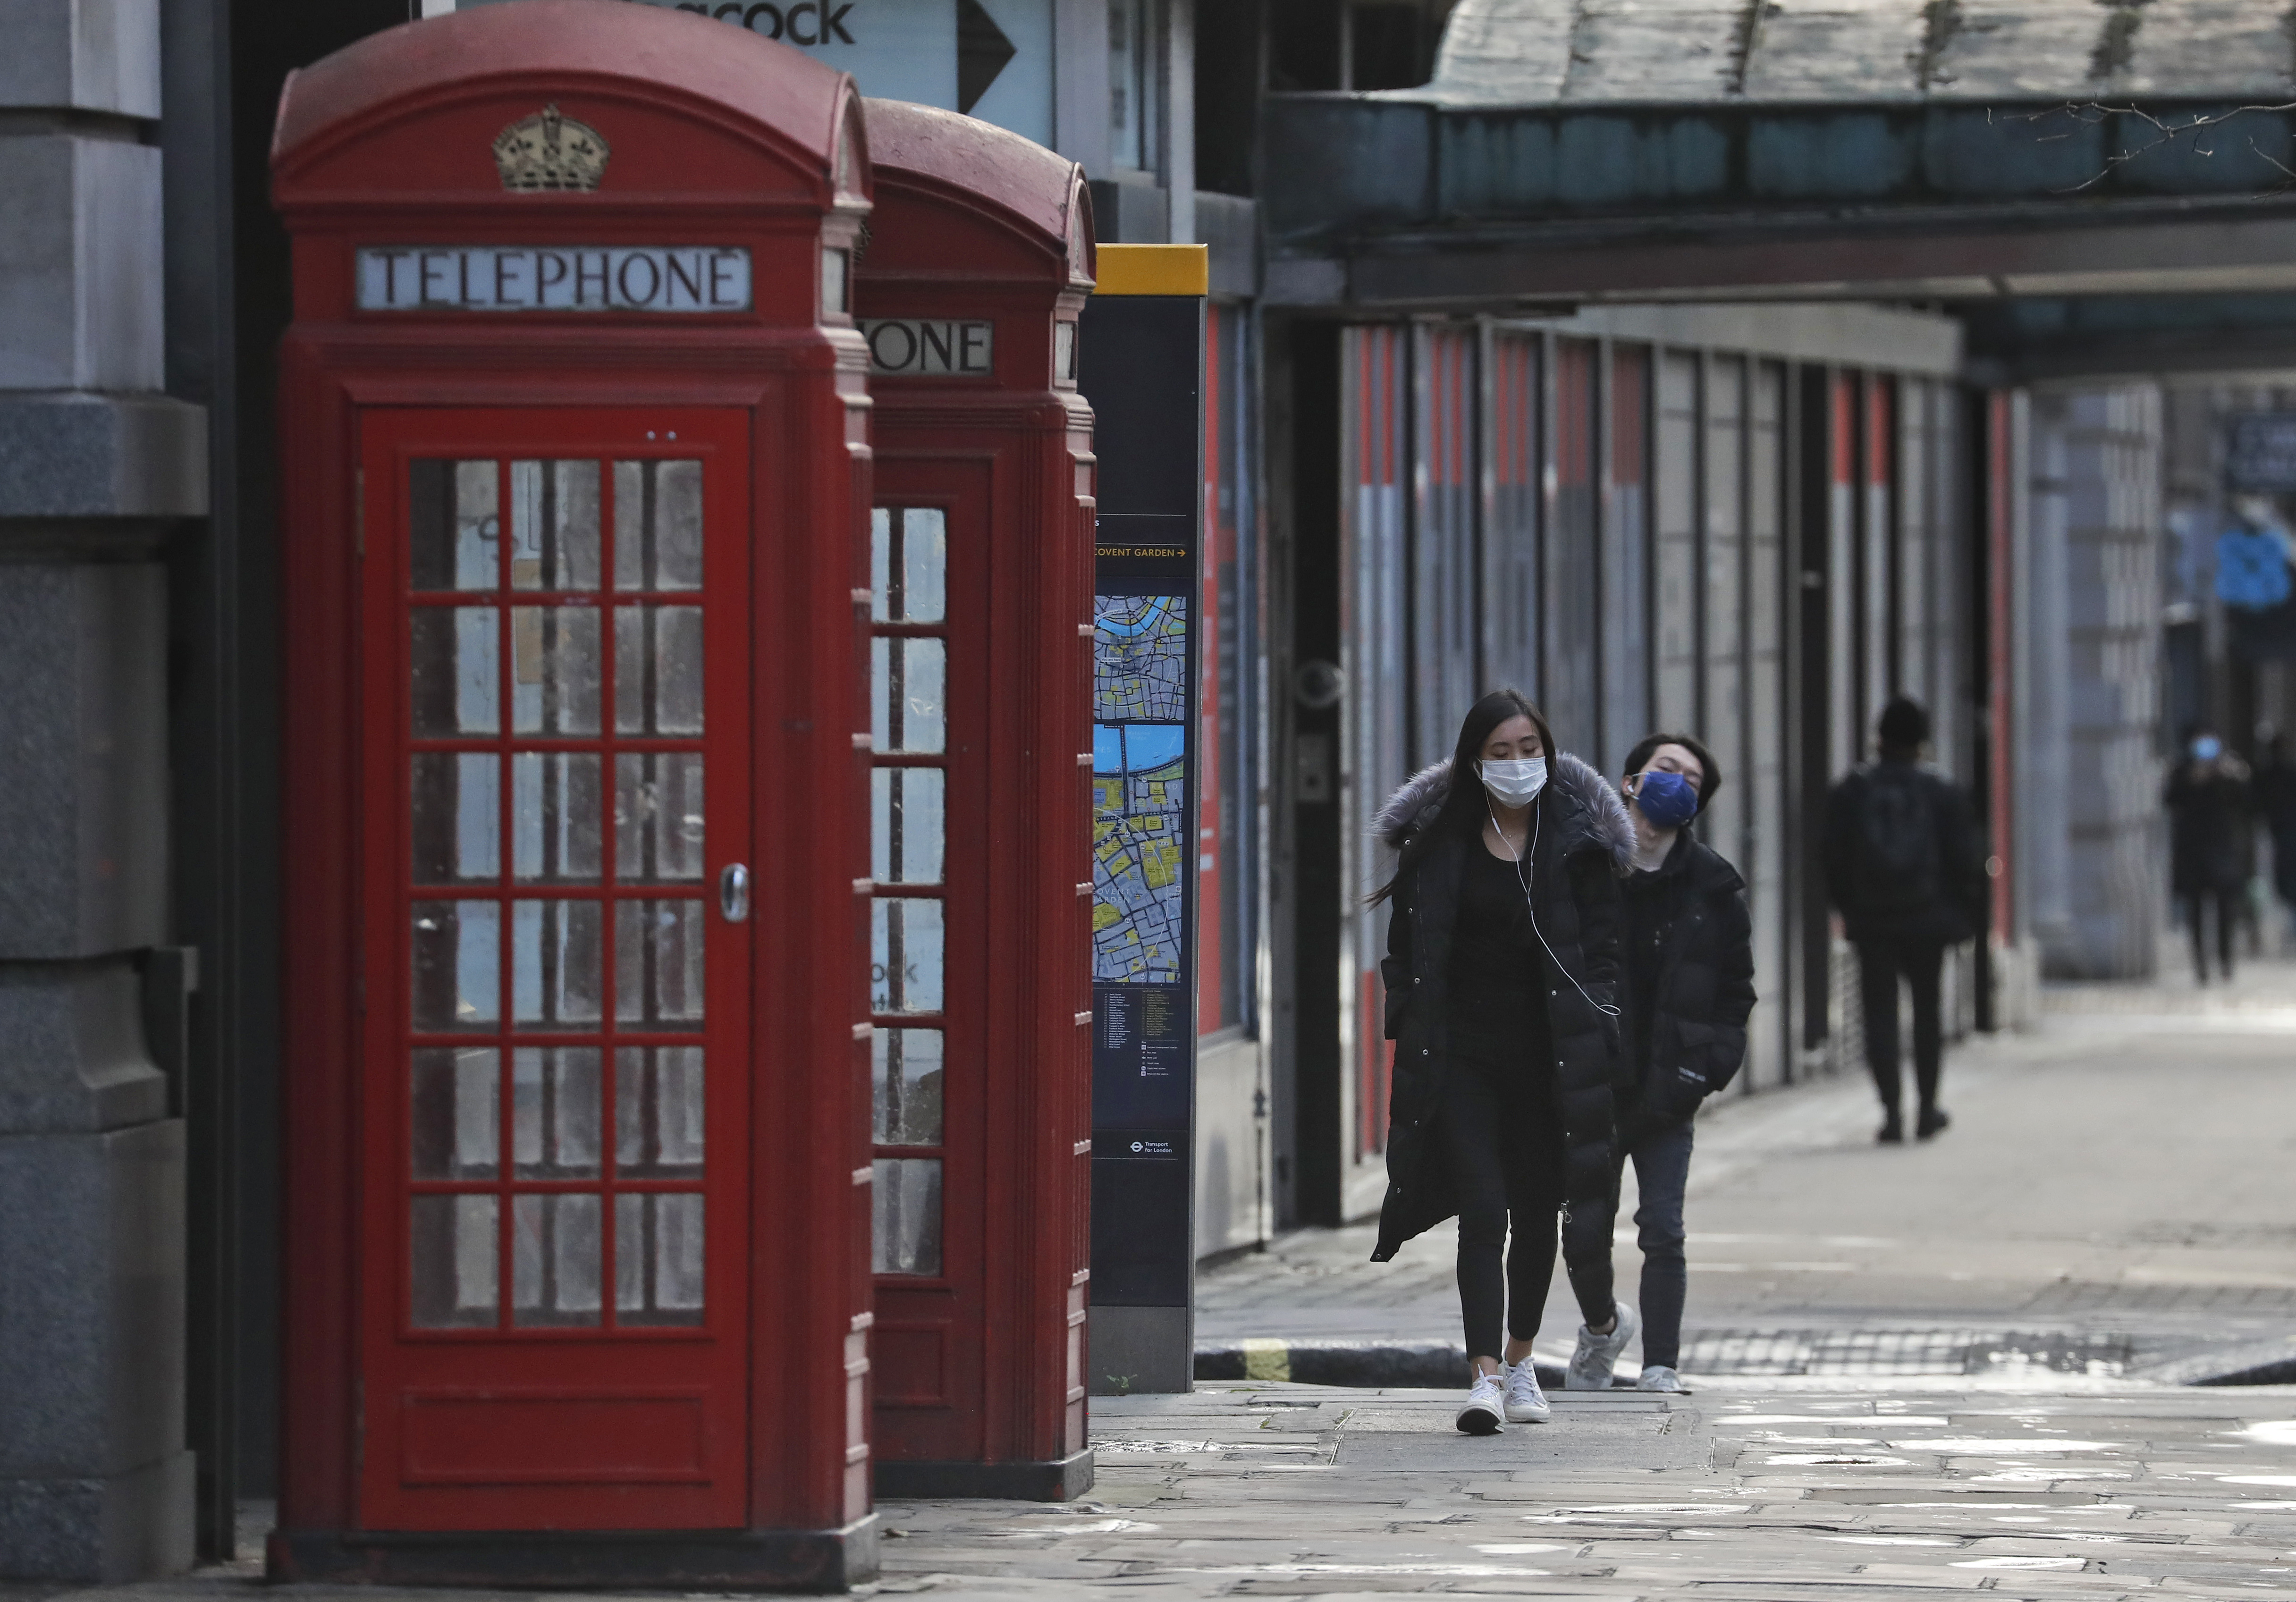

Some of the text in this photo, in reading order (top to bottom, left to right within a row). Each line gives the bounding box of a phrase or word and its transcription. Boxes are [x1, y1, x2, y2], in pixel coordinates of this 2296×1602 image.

[370, 251, 739, 306] TELEPHONE
[855, 320, 987, 371] ONE
[1134, 548, 1174, 557] GARDEN
